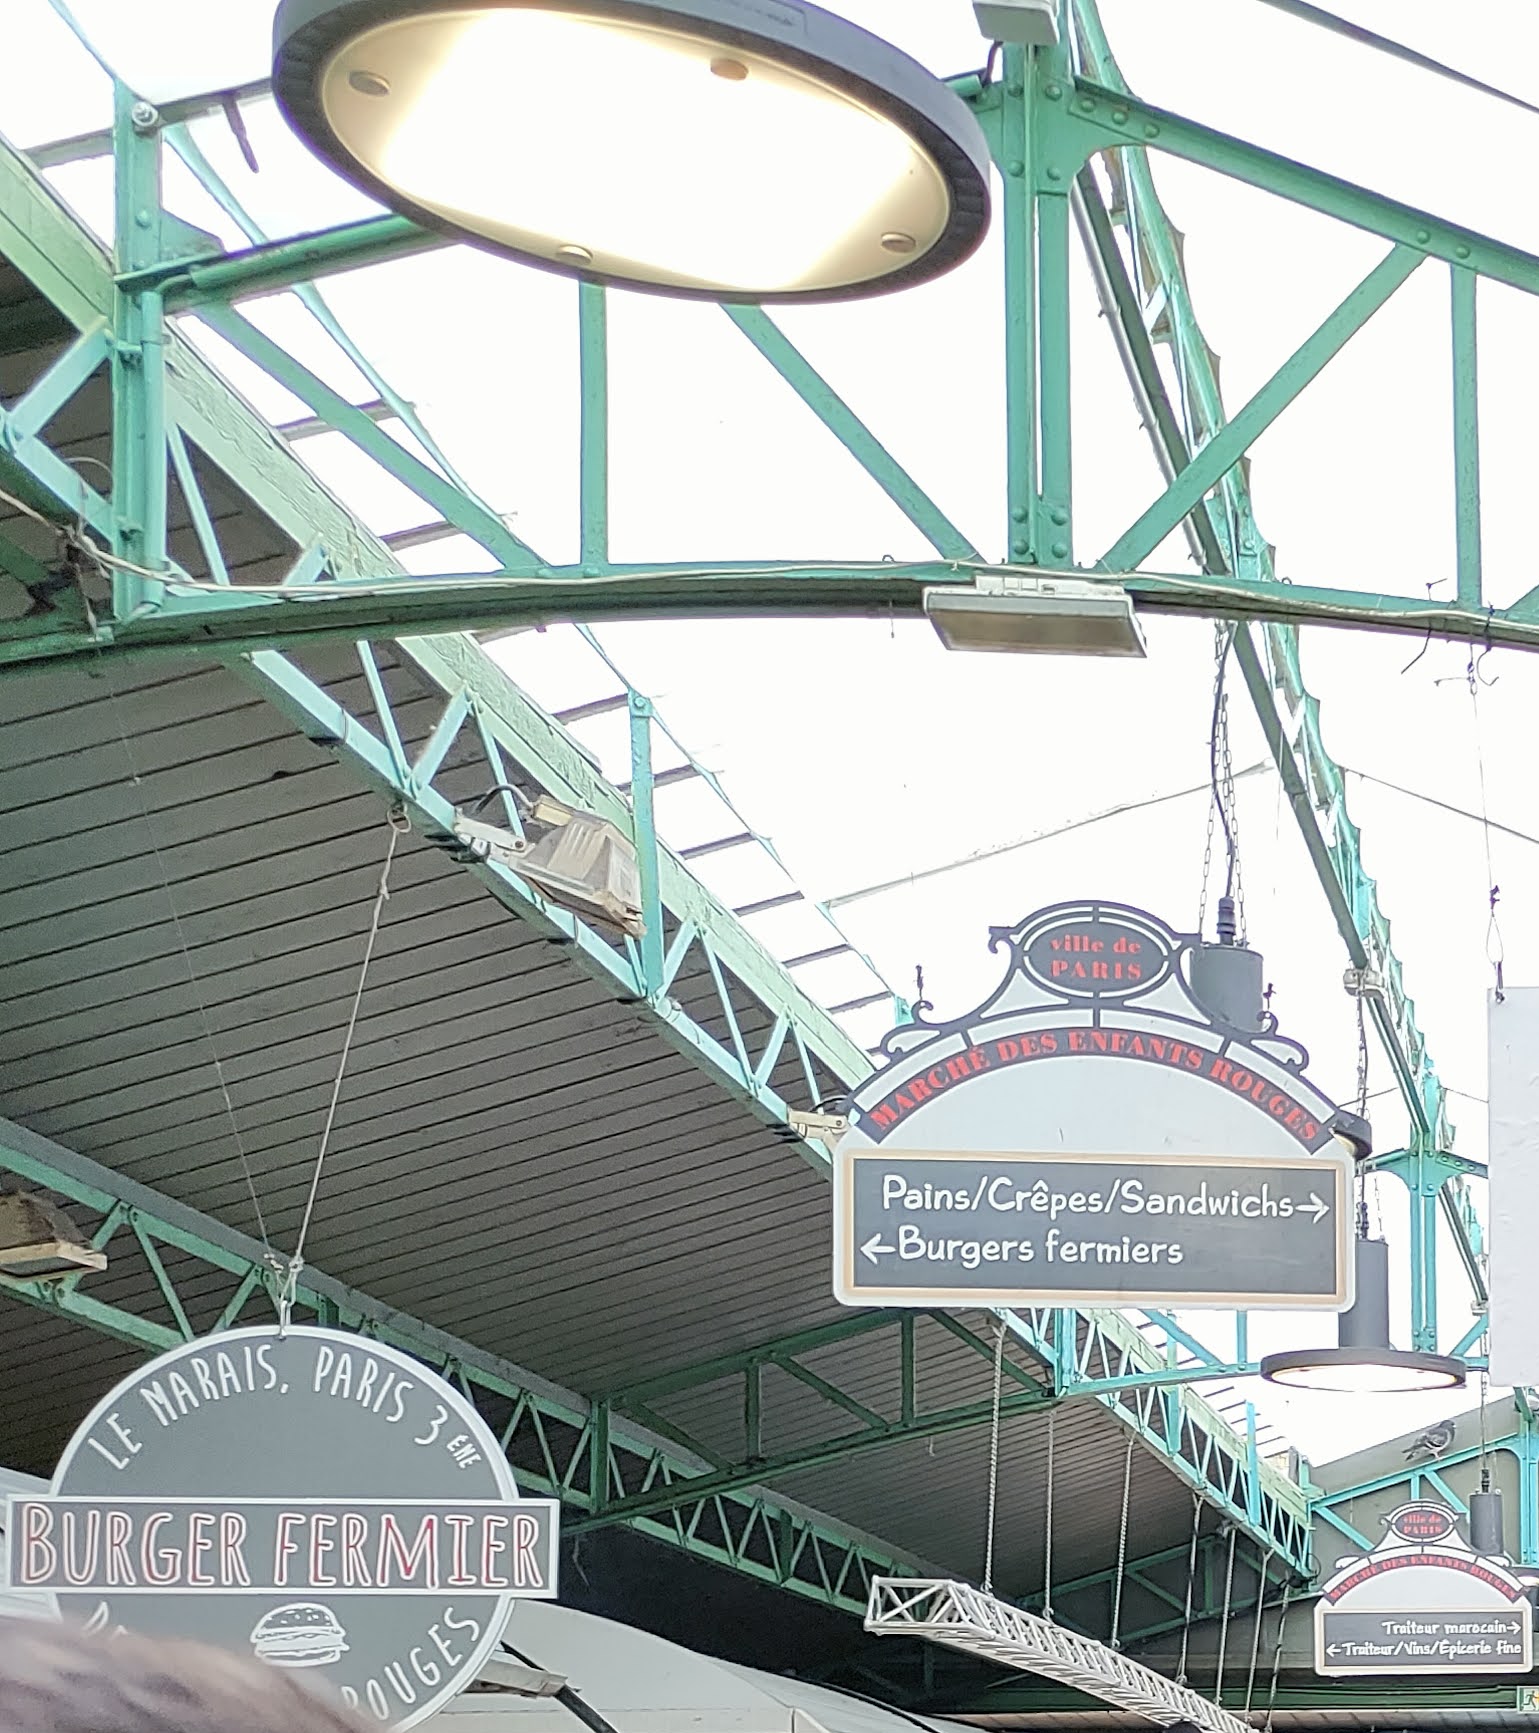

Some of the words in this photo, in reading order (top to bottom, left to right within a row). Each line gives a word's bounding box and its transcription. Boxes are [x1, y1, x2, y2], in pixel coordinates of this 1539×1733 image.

[1050, 936, 1105, 956] ville
[1112, 936, 1141, 956] de
[1051, 959, 1142, 980] PARIS
[870, 1043, 990, 1132] MARCHÉ
[998, 1030, 1059, 1063] DES
[1068, 1029, 1204, 1080] ENFANTS
[1208, 1058, 1321, 1140] ROUGES
[881, 1174, 1295, 1220] Pains/Crêpes/Sandwichs
[898, 1225, 1034, 1269] Burgers
[1045, 1228, 1184, 1265] fermiers
[88, 1412, 142, 1470] LE
[140, 1343, 288, 1427] MARAIS,
[312, 1344, 414, 1425] PARIS
[19, 1501, 250, 1588] BURGER
[272, 1512, 545, 1590] FERMIER
[1381, 1620, 1440, 1635] Traiteur
[1444, 1619, 1507, 1635] marocain
[1495, 1639, 1522, 1656] fine
